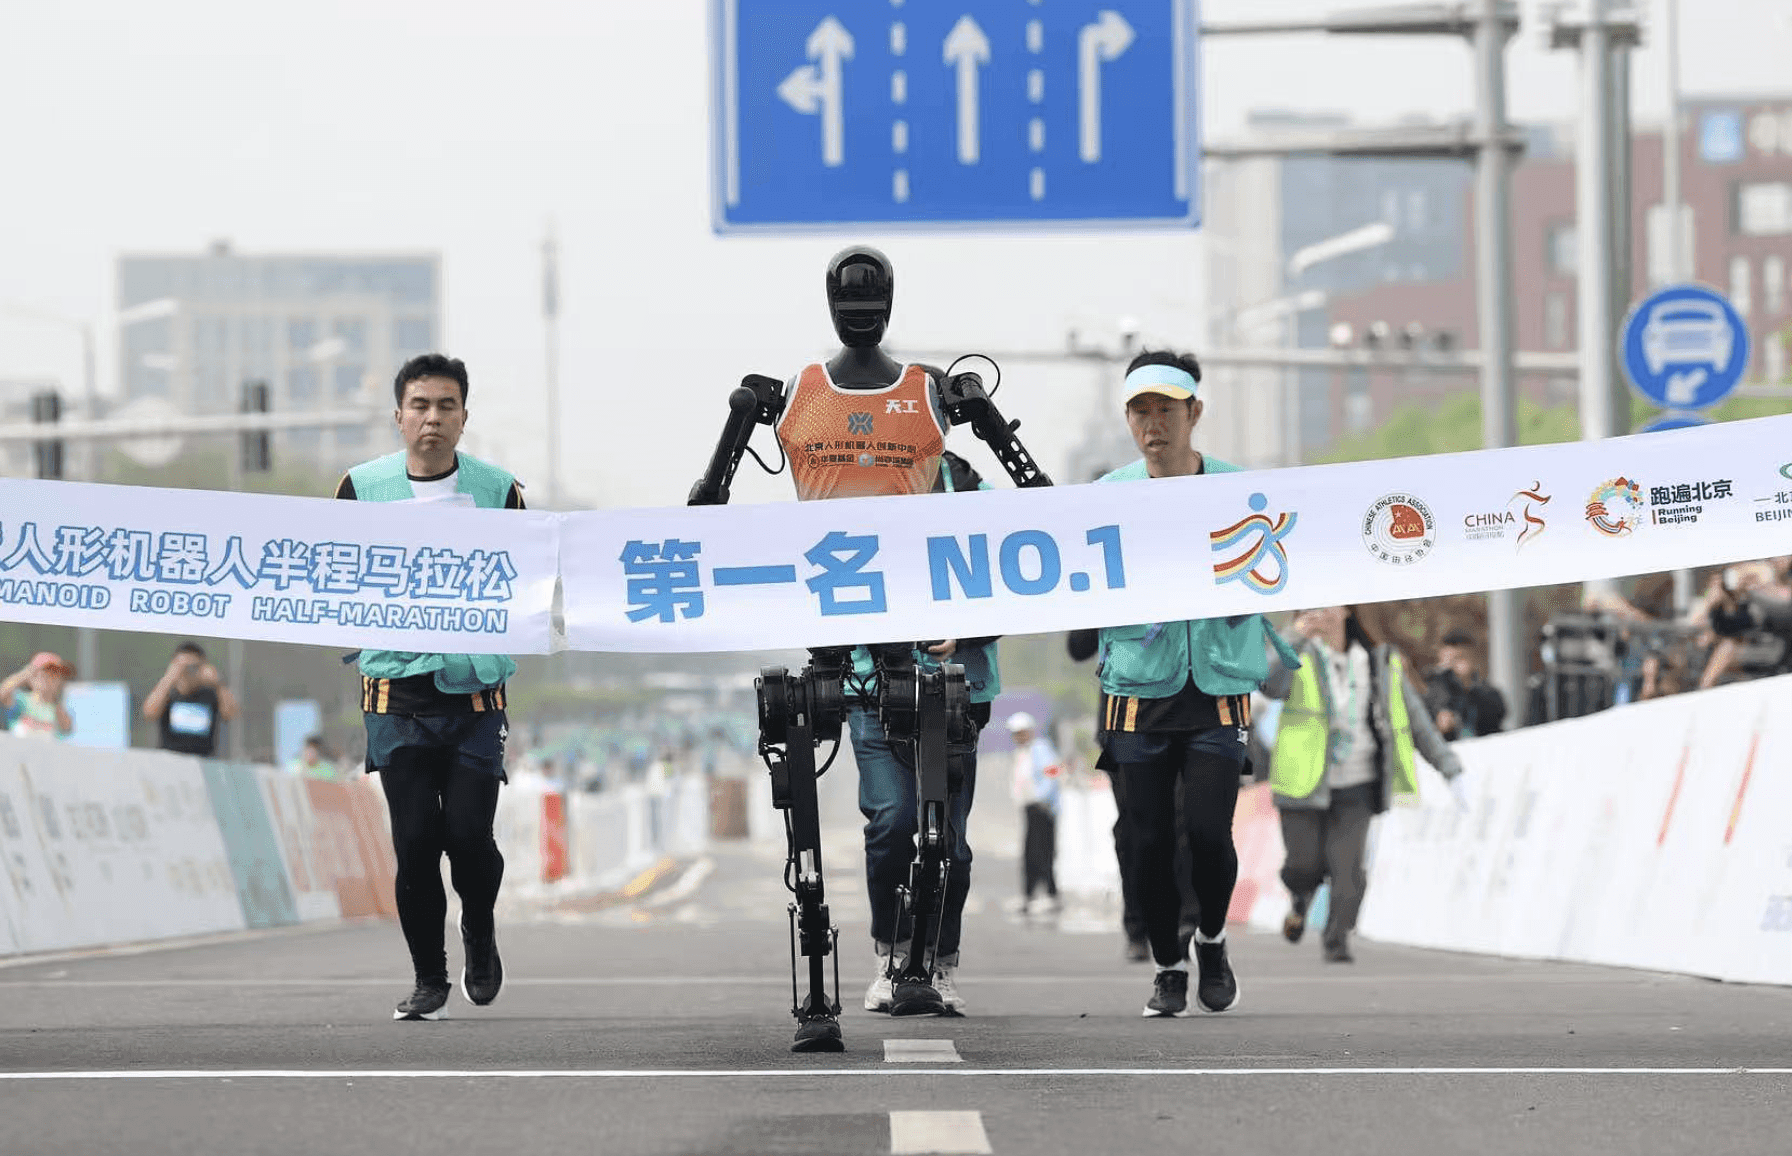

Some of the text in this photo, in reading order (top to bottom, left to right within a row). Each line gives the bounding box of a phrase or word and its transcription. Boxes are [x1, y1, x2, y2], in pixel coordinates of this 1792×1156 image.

[886, 399, 919, 414] 天工
[1650, 479, 1733, 506] 跑遍北京
[1774, 491, 1792, 504] 北
[1364, 495, 1433, 535] CHINESE ATHLETICS ASSOCIATION
[1464, 511, 1516, 527] CHINA
[1658, 505, 1703, 516] Running
[1659, 514, 1698, 525] Beijing
[0, 521, 517, 602] 人形机器人半程马拉松
[619, 524, 1127, 623] 第一名 NO.1
[130, 588, 232, 618] ROBOT
[252, 596, 508, 633] HALF-MARATHON
